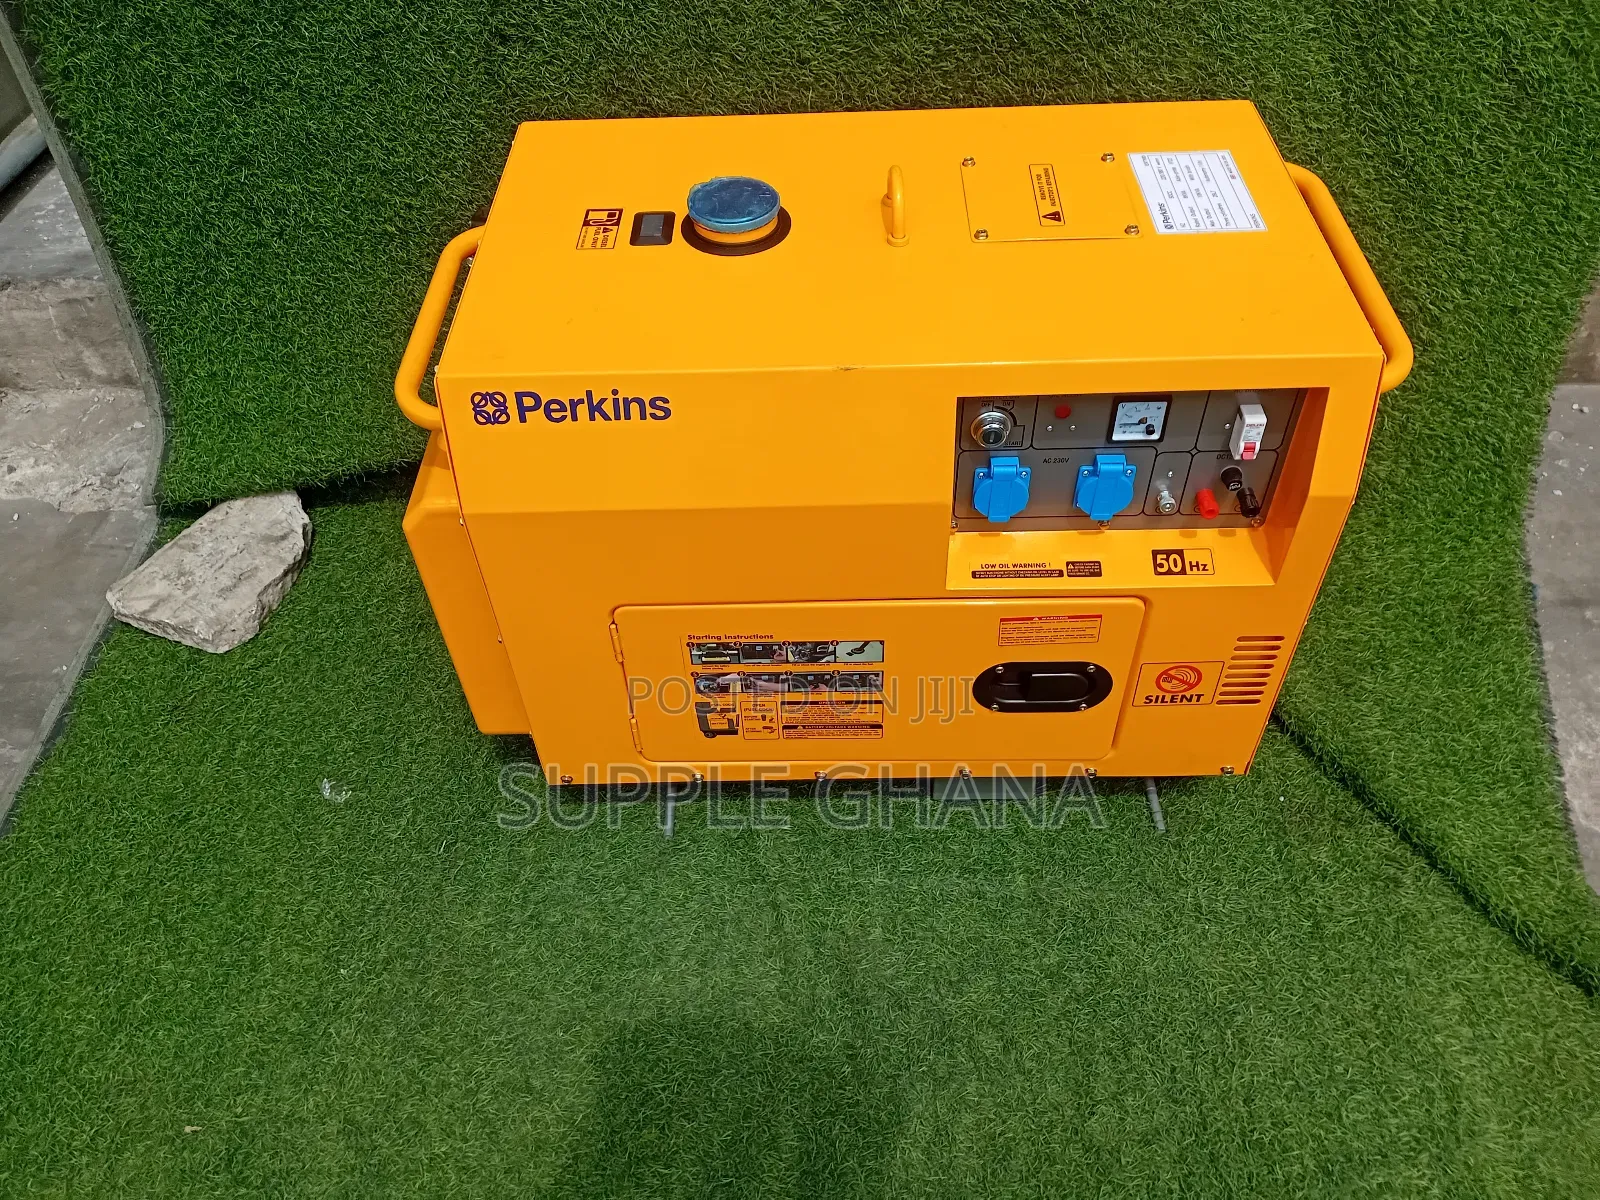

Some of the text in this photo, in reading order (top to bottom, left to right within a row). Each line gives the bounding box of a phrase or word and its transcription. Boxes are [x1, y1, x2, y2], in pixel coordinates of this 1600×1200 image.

[1158, 202, 1172, 224] Perkins
[514, 388, 672, 423] Perkins
[1156, 554, 1209, 572] 50 Hz
[1143, 694, 1204, 704] SILENT
